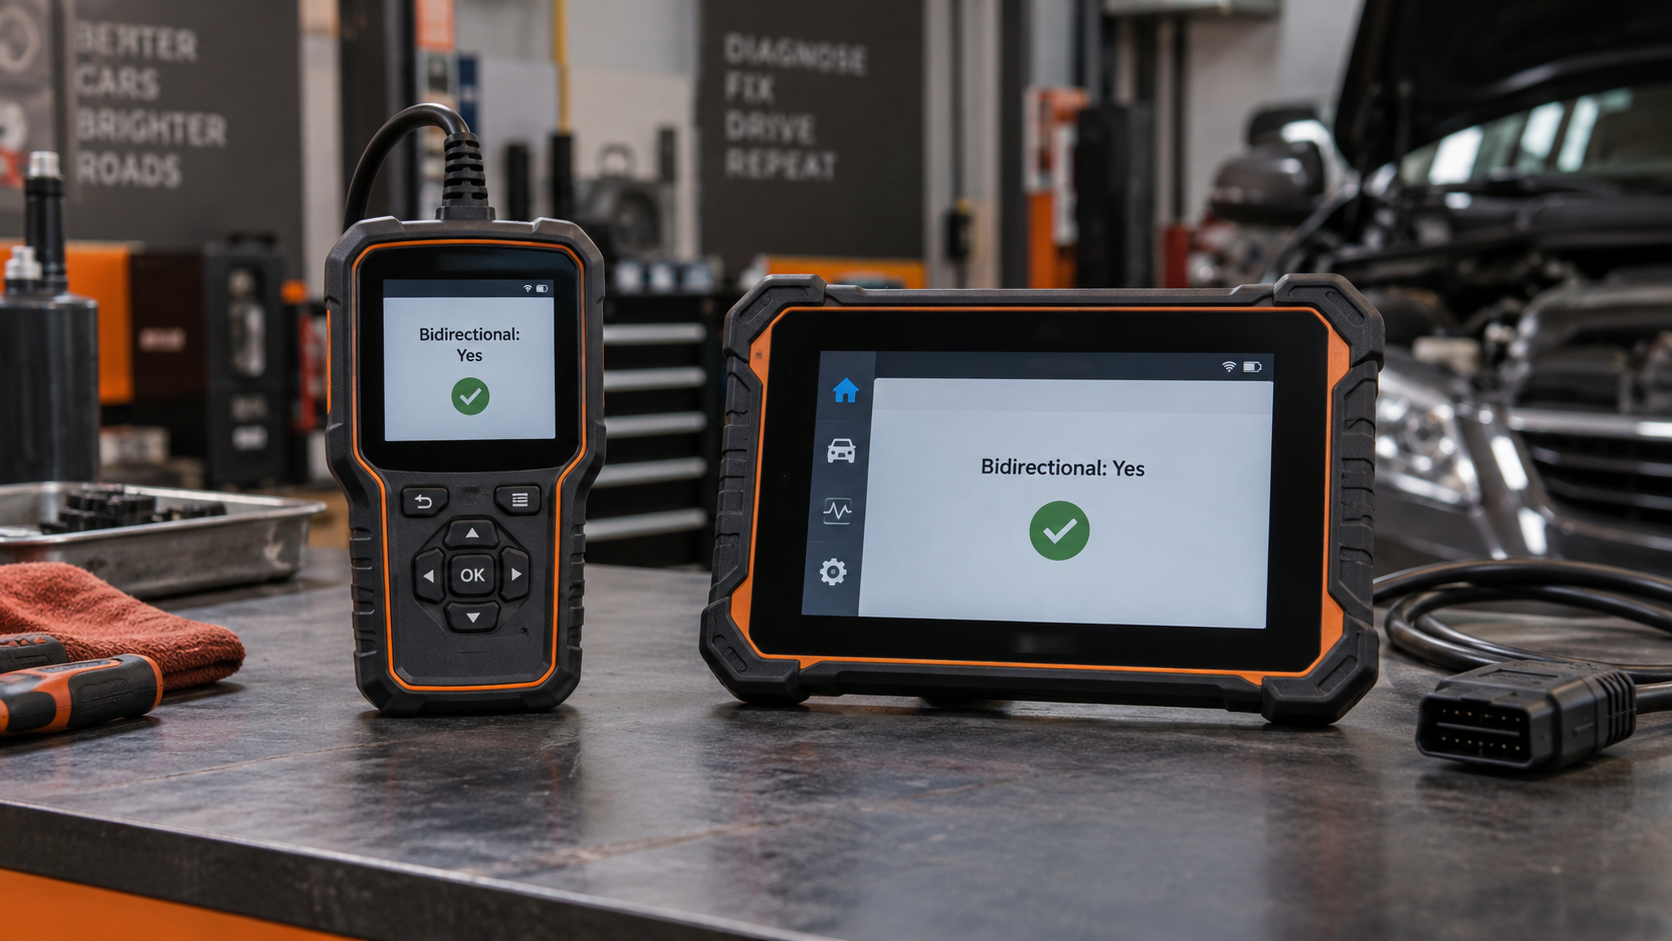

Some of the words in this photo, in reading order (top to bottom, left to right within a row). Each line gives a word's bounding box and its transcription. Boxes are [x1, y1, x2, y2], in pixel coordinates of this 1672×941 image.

[725, 33, 867, 77] DIAGNOSE
[75, 64, 160, 101] CARS
[725, 70, 775, 104] FIX
[77, 107, 227, 147] BRIGHTER
[725, 109, 815, 145] DRIVE
[77, 152, 182, 188] ROADS
[725, 148, 838, 182] REPEAT
[419, 327, 520, 341] Bidirectional:
[457, 349, 483, 362] Yes
[981, 458, 1107, 476] Bidirectional:
[1112, 460, 1145, 477] Yes
[460, 568, 485, 582] OK
